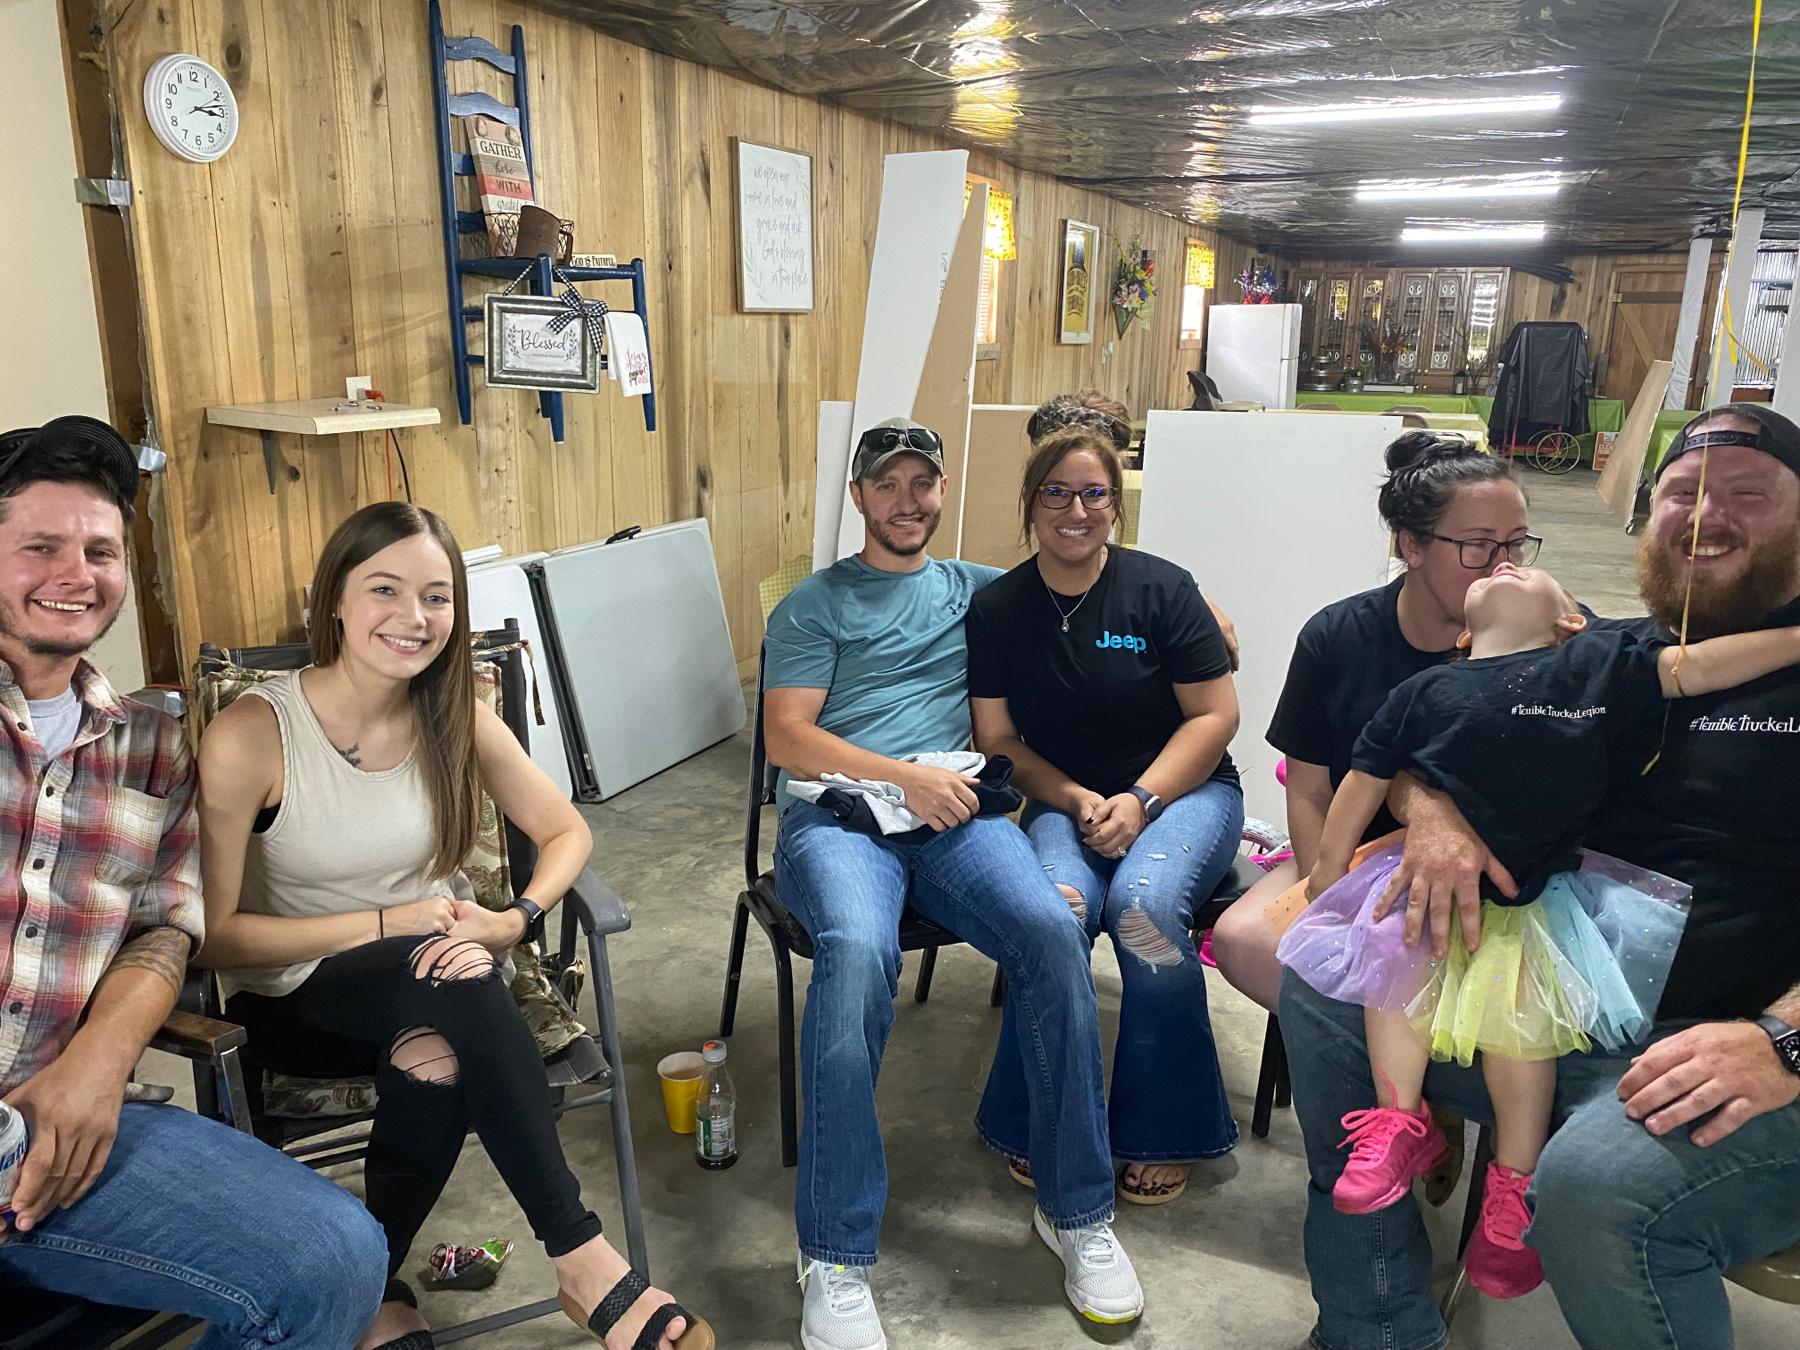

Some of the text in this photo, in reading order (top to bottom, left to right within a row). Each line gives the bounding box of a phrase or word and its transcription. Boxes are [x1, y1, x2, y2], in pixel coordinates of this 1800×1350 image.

[177, 73, 182, 84] 11
[189, 71, 198, 82] 12
[168, 83, 177, 95] 10
[213, 91, 220, 101] 2
[165, 98, 172, 109] 9
[218, 108, 225, 118] 3
[171, 115, 178, 126] 8
[216, 123, 222, 133] 4
[182, 129, 188, 139] 7
[208, 133, 214, 143] 5
[195, 135, 201, 146] 6
[480, 140, 521, 160] GATHER
[496, 179, 522, 194] WITH
[517, 329, 569, 351] Blessed
[1095, 630, 1147, 654] Jeep
[1690, 715, 1800, 733] #TerribleTruckerL
